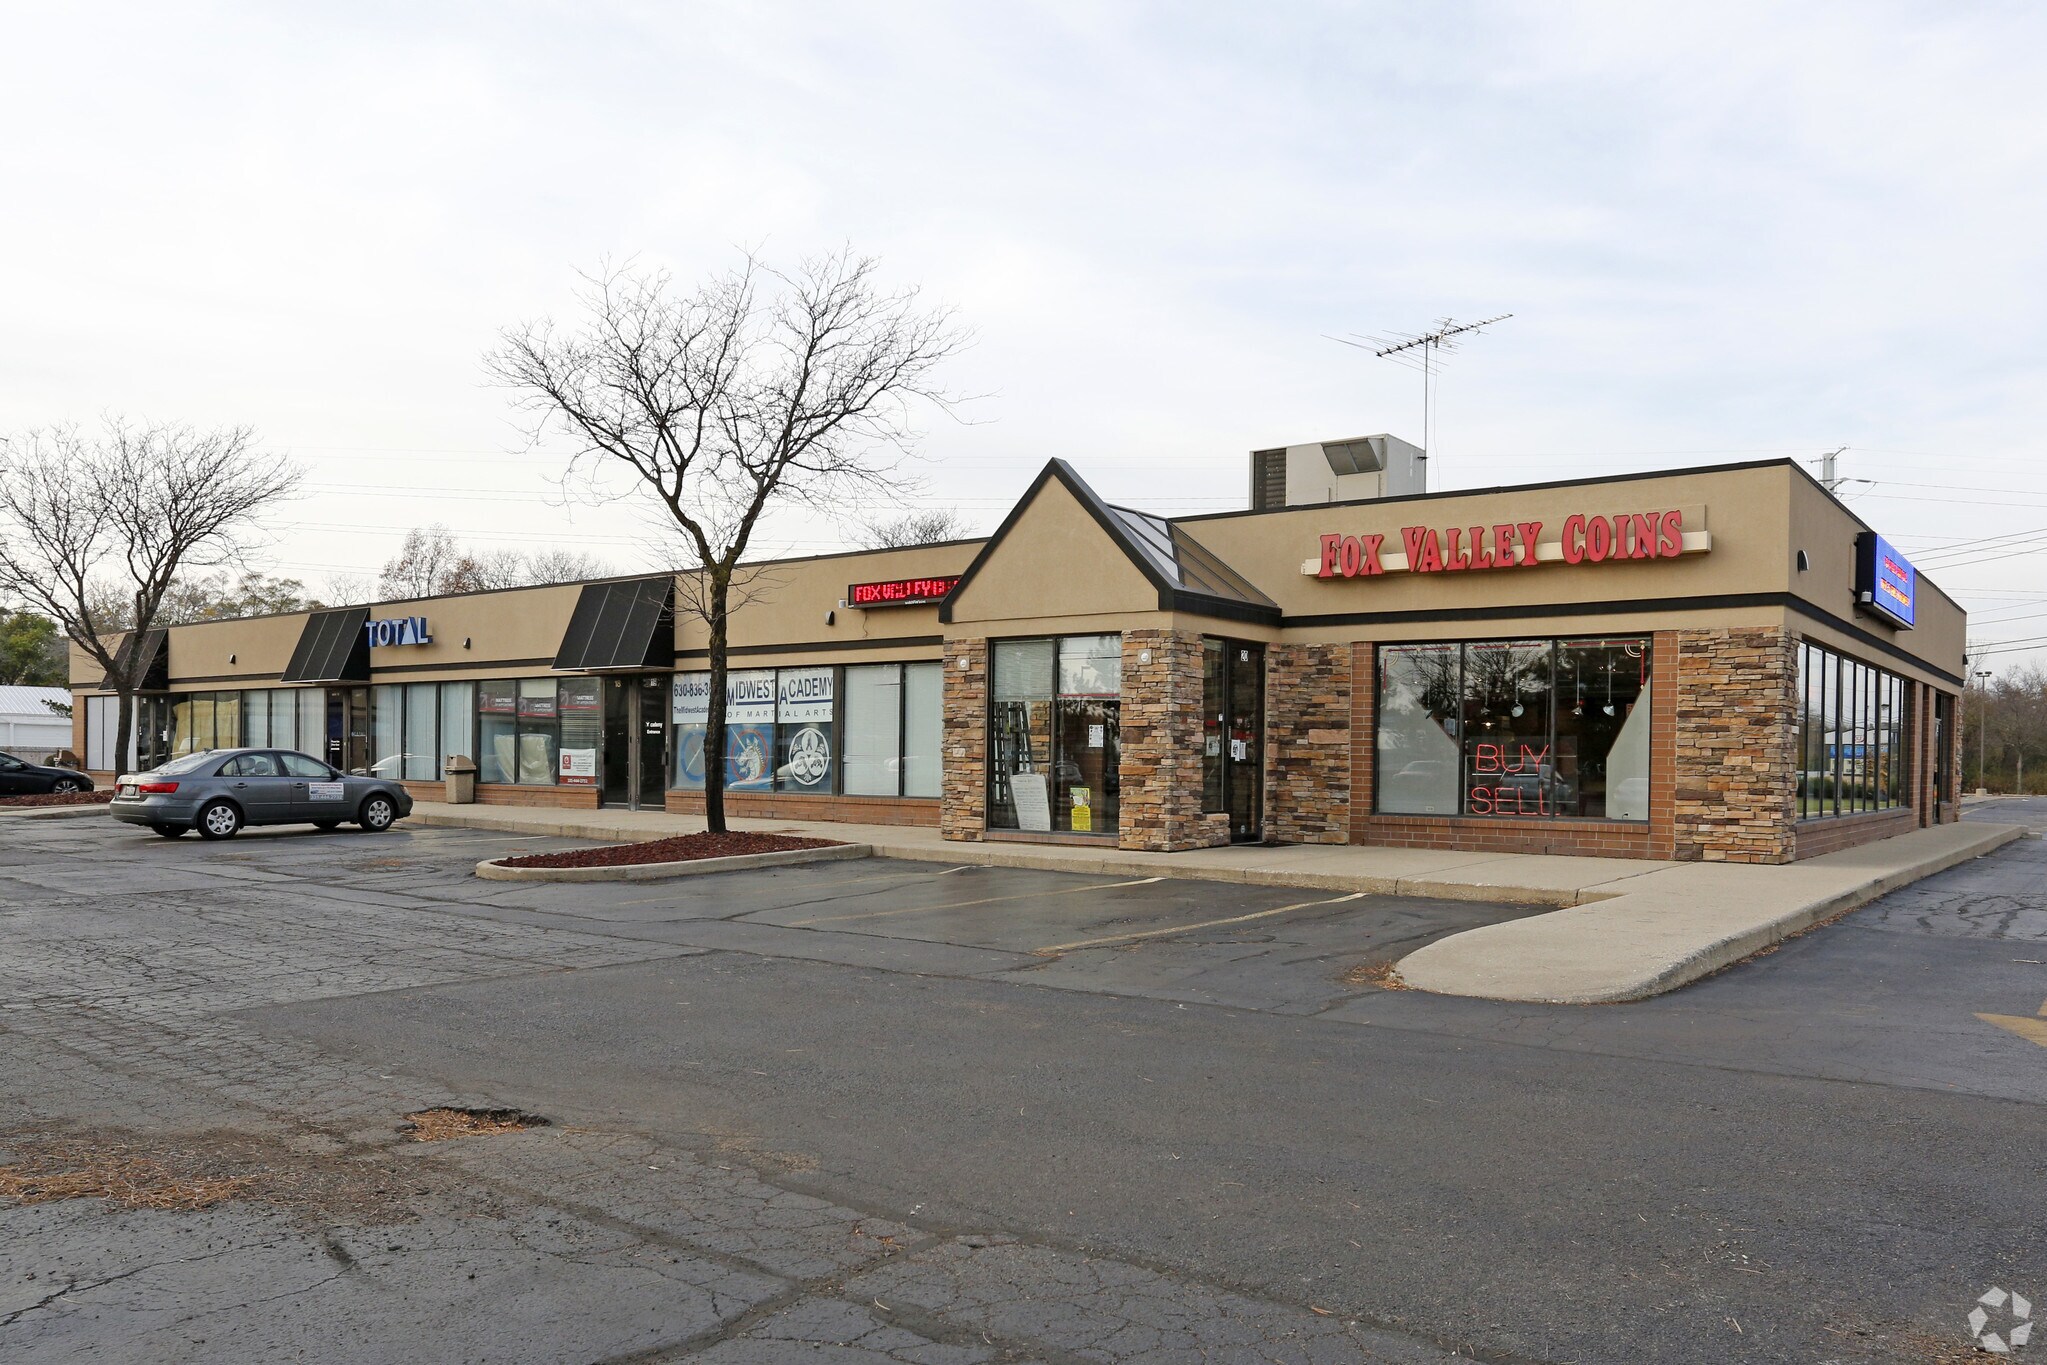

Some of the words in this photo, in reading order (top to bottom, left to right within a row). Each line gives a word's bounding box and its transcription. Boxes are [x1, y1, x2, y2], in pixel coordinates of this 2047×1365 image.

[1318, 533, 1384, 577] FOX
[1400, 521, 1543, 572] VALLEY
[1561, 509, 1683, 564] COINS
[855, 585, 881, 602] FOX
[366, 616, 432, 648] TOTAL
[727, 679, 776, 706] MIDWEST
[779, 677, 834, 705] ACADEMY
[746, 709, 798, 718] MARTIAL
[805, 708, 834, 717] ARTS
[1475, 743, 1549, 773] BUY
[1471, 786, 1561, 816] SELL
